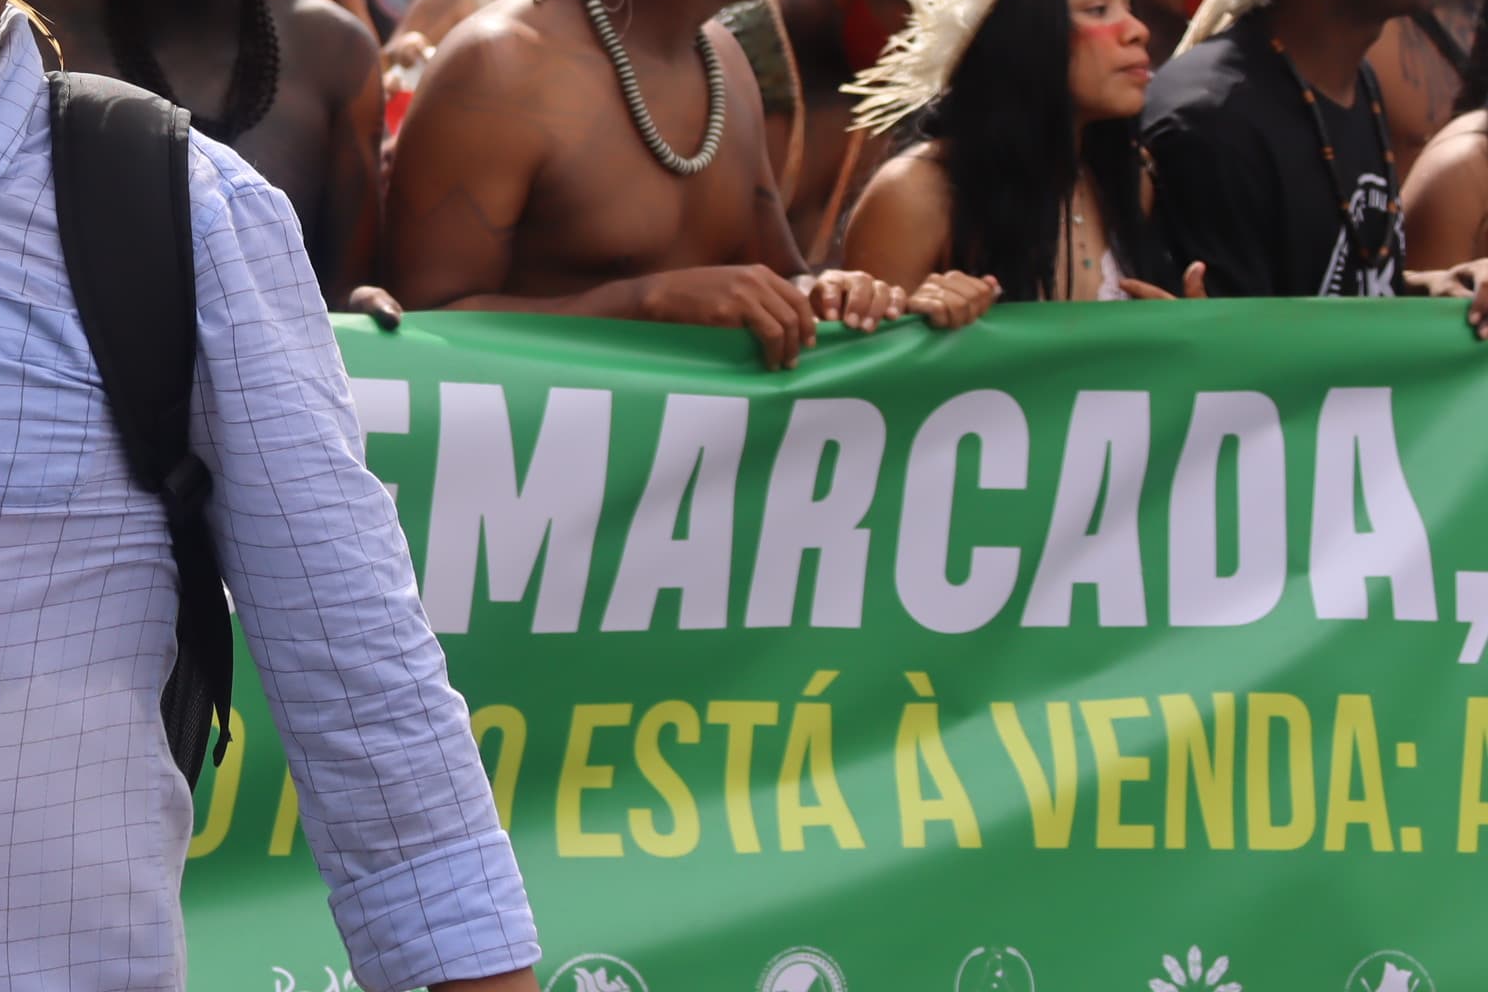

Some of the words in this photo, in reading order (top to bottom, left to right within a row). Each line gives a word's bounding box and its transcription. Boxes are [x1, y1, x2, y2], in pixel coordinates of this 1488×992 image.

[349, 377, 1488, 664] MARCADA,
[555, 670, 866, 858] ESTÁ
[893, 670, 983, 850] À
[989, 692, 1424, 854] VENDA:
